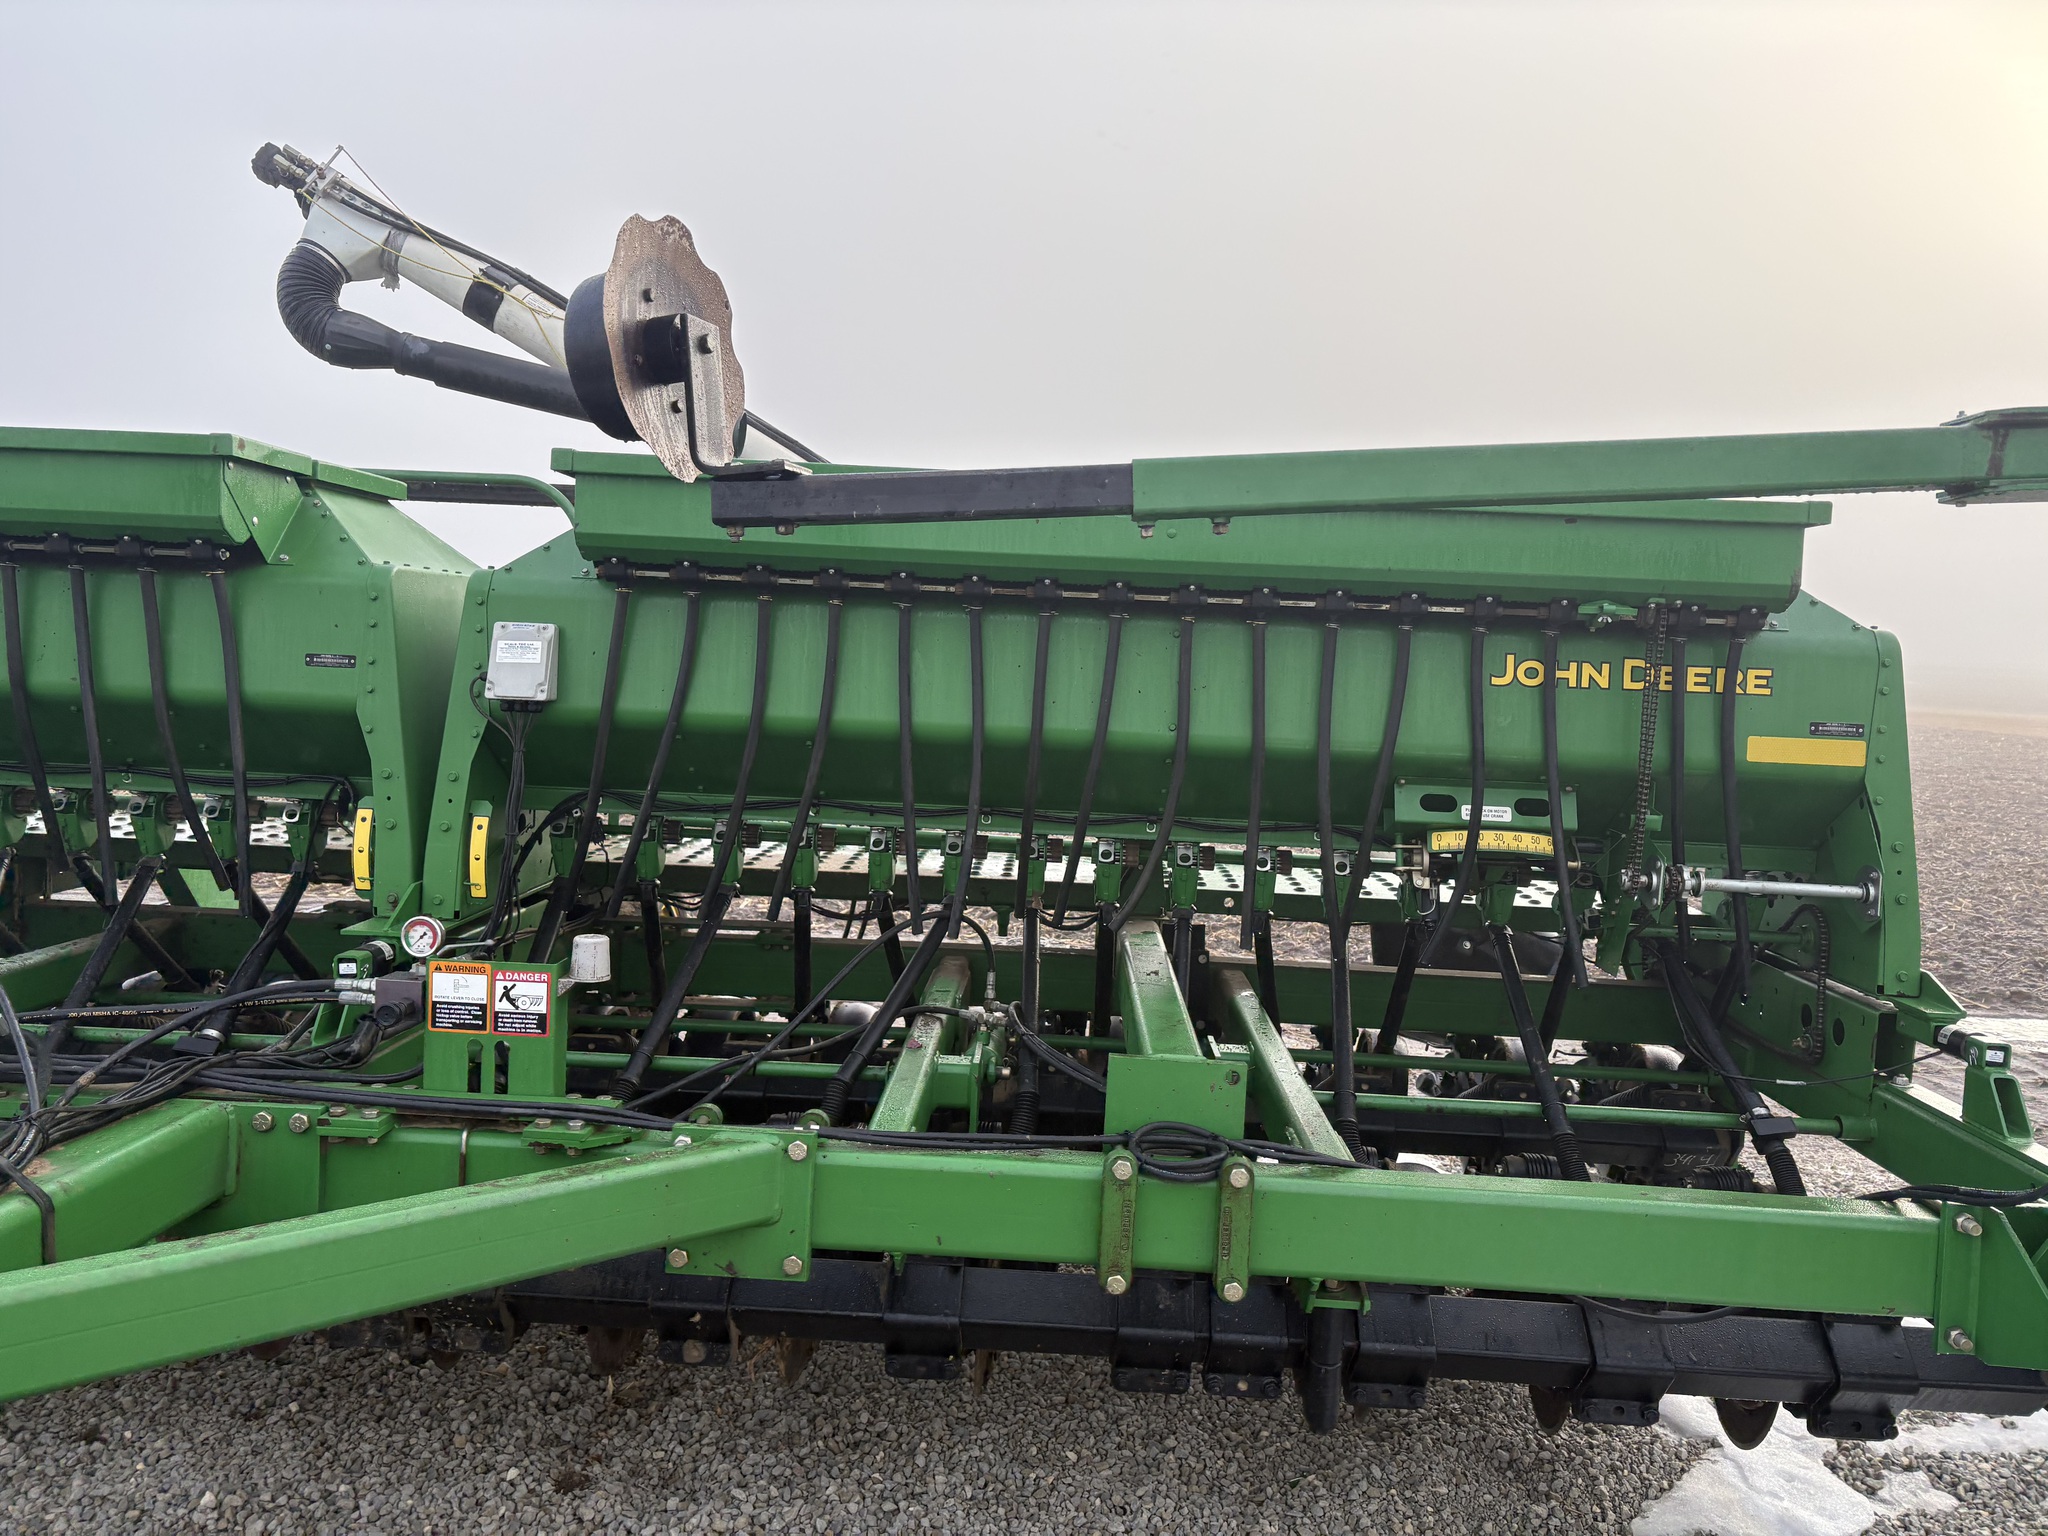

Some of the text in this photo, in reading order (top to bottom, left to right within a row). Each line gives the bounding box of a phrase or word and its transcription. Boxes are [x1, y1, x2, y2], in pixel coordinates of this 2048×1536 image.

[1490, 652, 1774, 696] JOHN DEERE
[1437, 834, 1442, 842] 0
[1454, 832, 1464, 842] 10
[1493, 832, 1504, 842] 30
[1512, 834, 1523, 843] 40
[1530, 835, 1541, 845] 50
[445, 965, 486, 973] WARNING
[506, 972, 547, 981] DANGER
